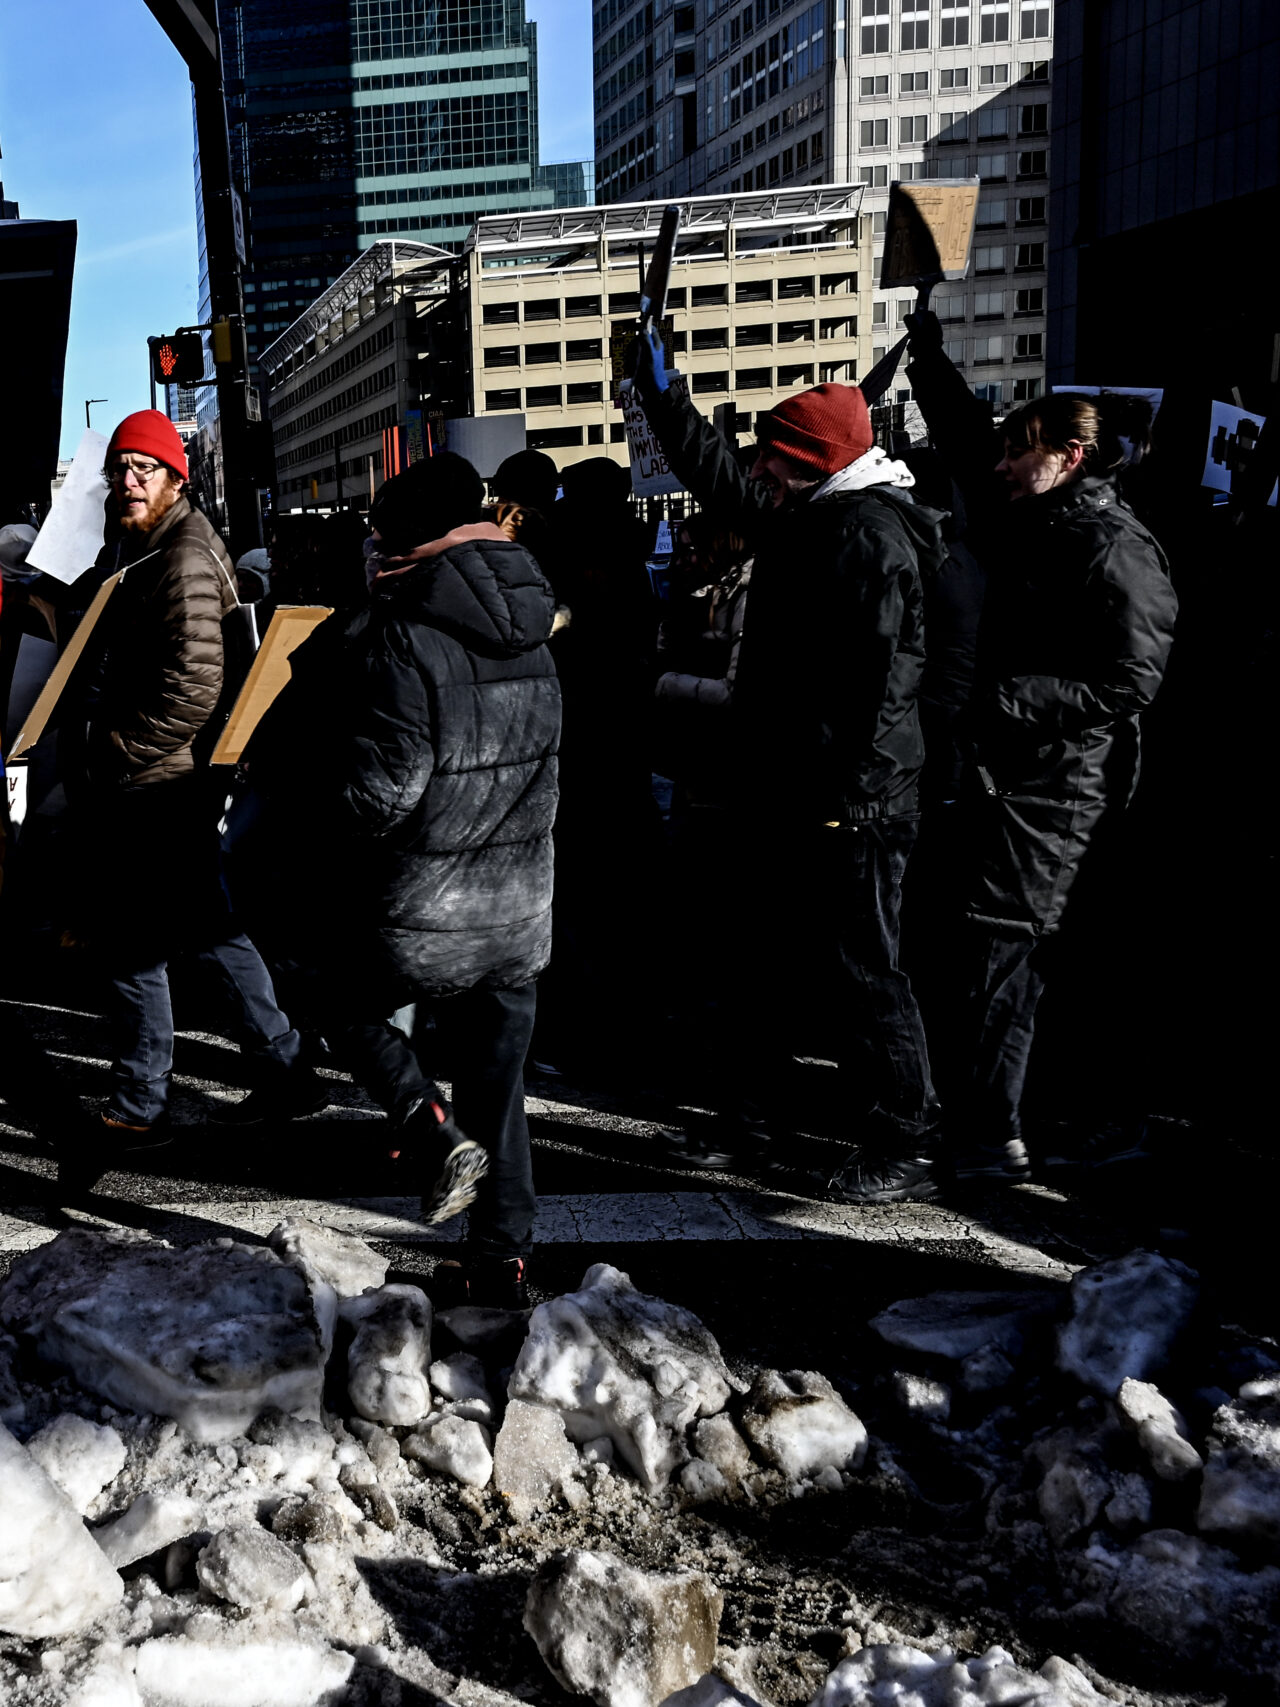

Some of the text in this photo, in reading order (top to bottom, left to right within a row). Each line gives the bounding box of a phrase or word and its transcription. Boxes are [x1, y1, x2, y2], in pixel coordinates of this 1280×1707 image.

[625, 410, 644, 424] WAS
[627, 426, 643, 438] THE
[640, 455, 670, 478] LAB
